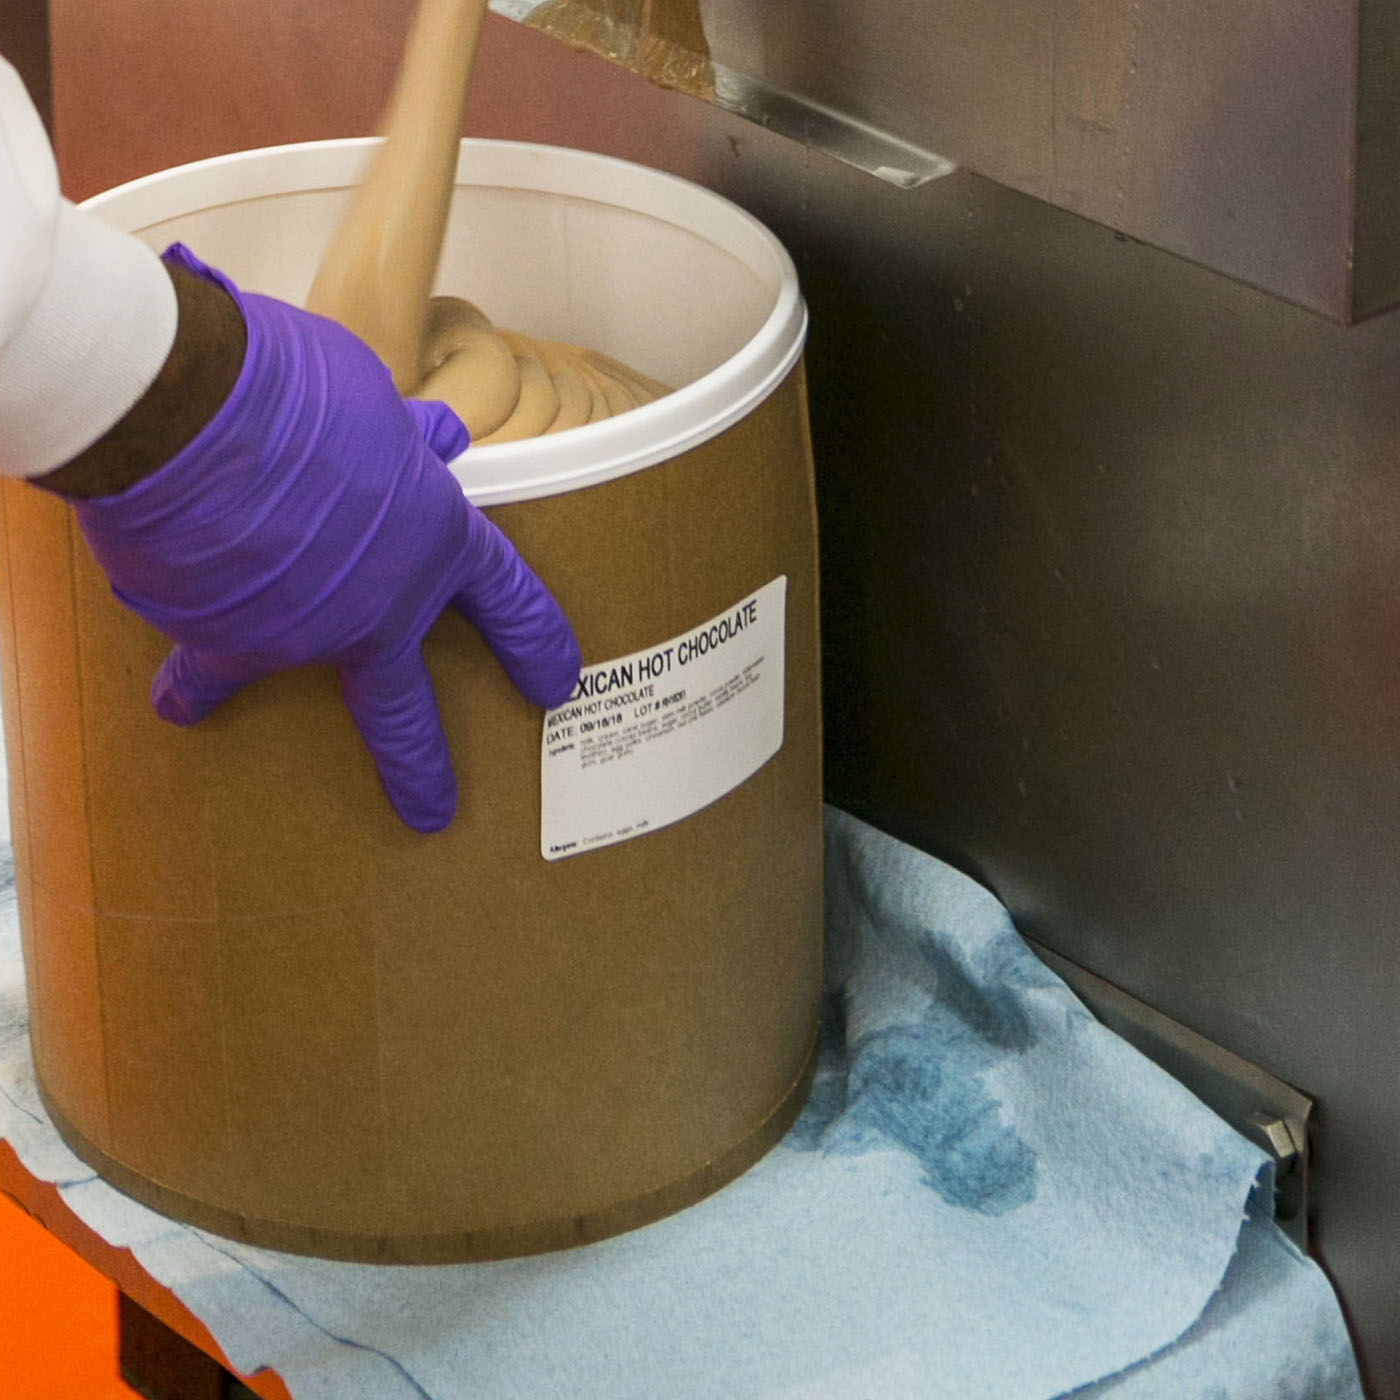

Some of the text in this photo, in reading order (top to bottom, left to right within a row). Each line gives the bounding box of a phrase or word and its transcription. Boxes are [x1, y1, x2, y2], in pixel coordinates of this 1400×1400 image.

[570, 663, 633, 700] XICAN
[639, 648, 673, 682] HOT
[678, 599, 757, 666] CHOCOLATE
[547, 706, 583, 729] MEXICAN
[584, 700, 602, 716] HOT
[604, 684, 654, 711] CHOCOLATE
[634, 703, 653, 718] LOT
